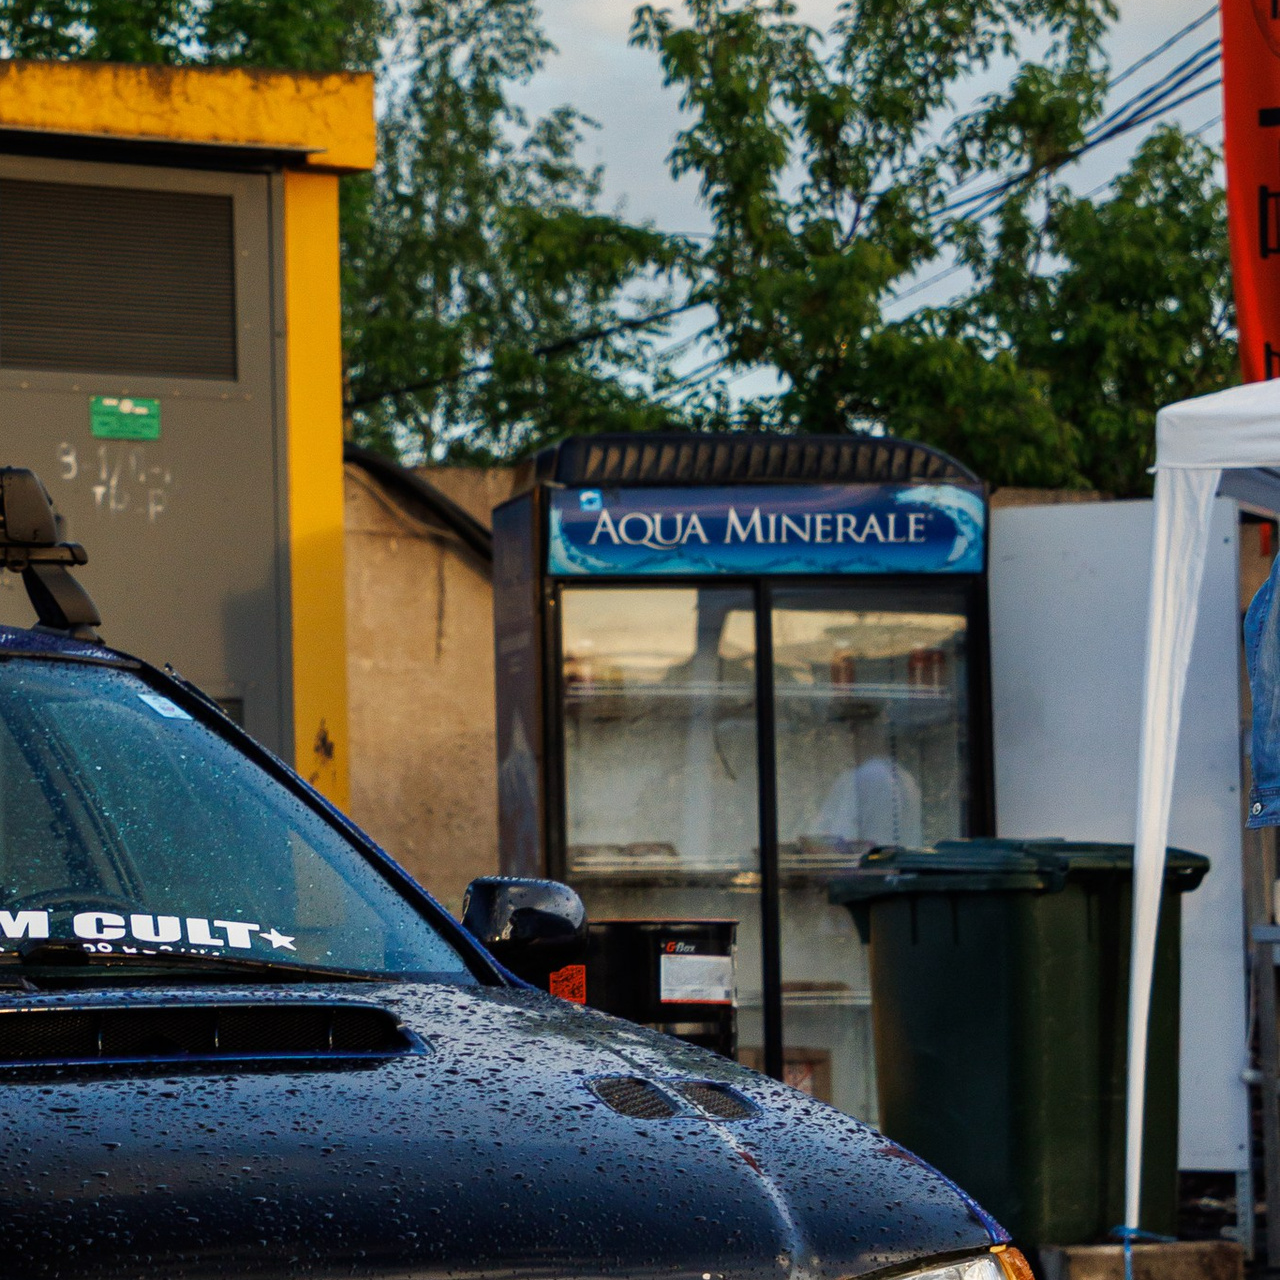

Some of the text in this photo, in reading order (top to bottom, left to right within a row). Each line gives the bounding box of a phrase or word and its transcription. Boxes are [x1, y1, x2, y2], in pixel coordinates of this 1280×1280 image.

[588, 507, 927, 550] AQUA MINERALE
[73, 911, 260, 949] CULT
